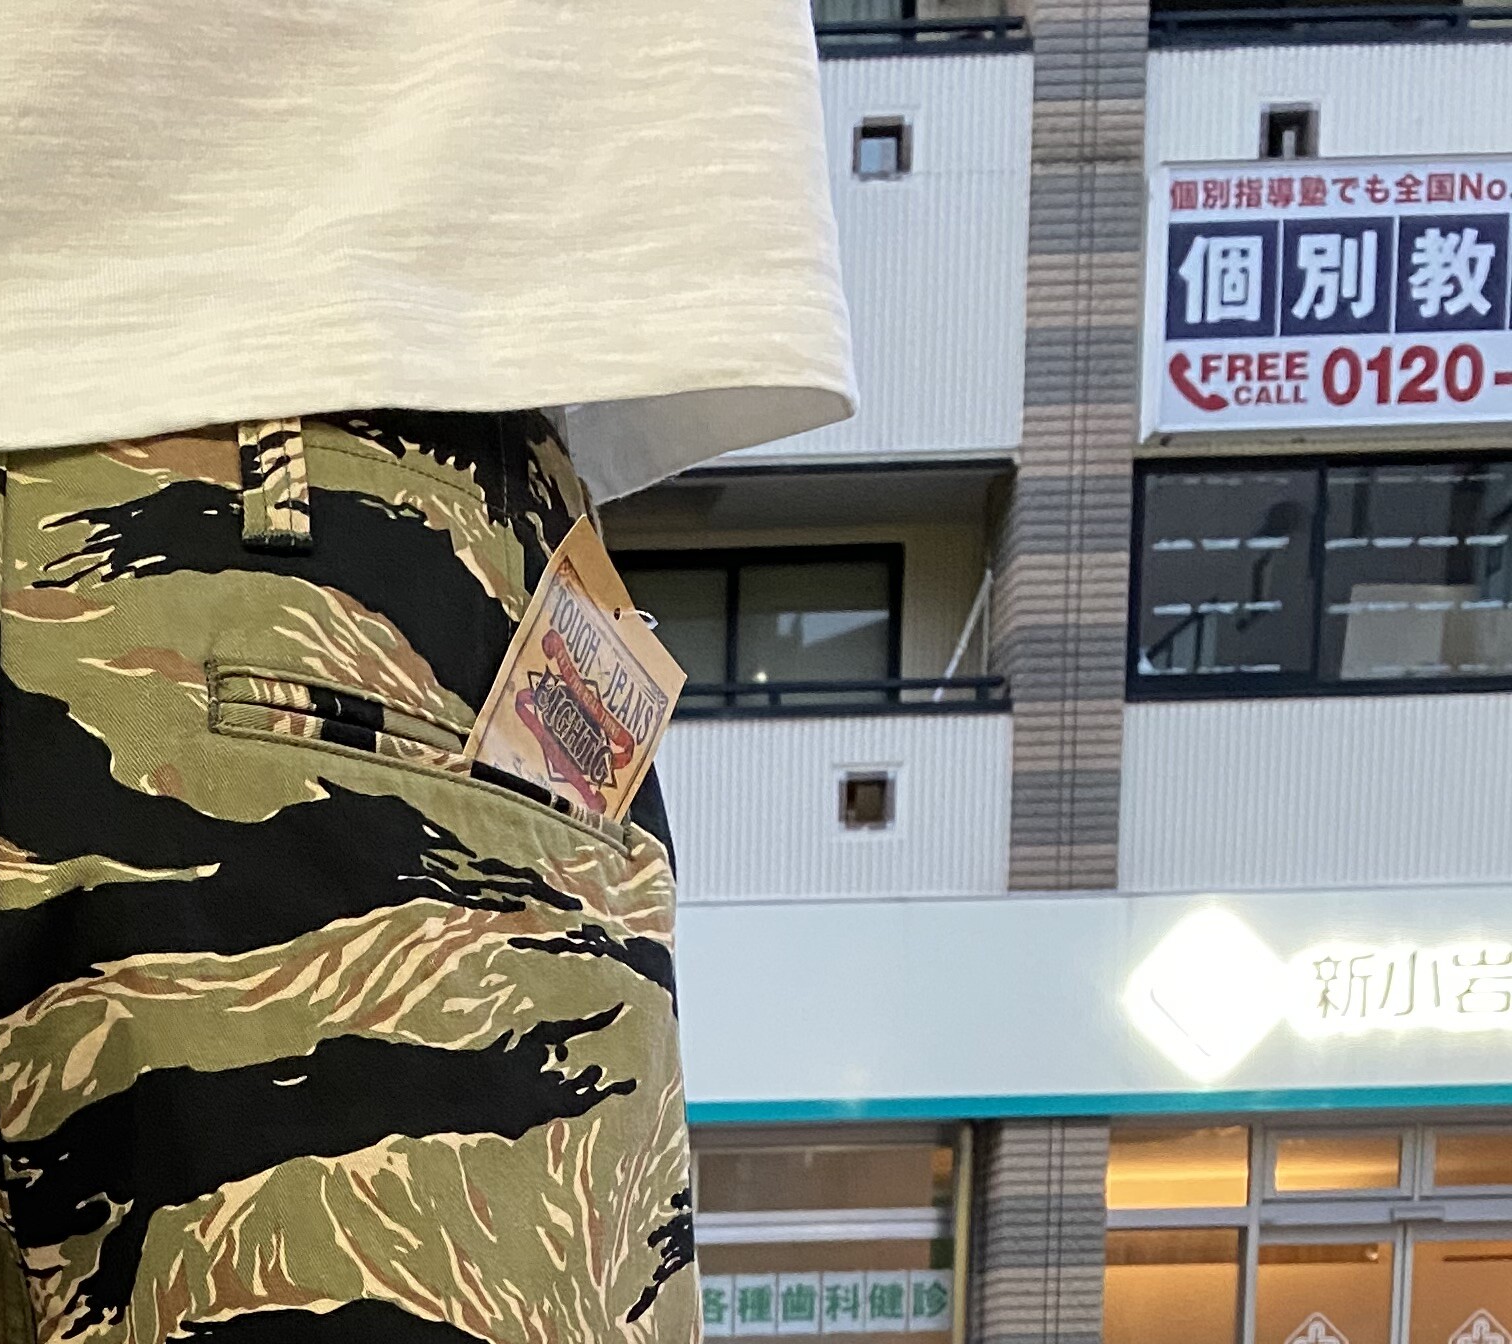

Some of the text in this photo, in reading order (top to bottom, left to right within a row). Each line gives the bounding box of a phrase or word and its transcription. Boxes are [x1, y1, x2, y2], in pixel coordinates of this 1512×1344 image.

[1178, 227, 1496, 324] 個別教
[1200, 350, 1309, 384] FREE
[1234, 384, 1309, 407] CALL
[550, 589, 654, 745] TOUGH JEANS
[1312, 949, 1512, 1019] 新小岩
